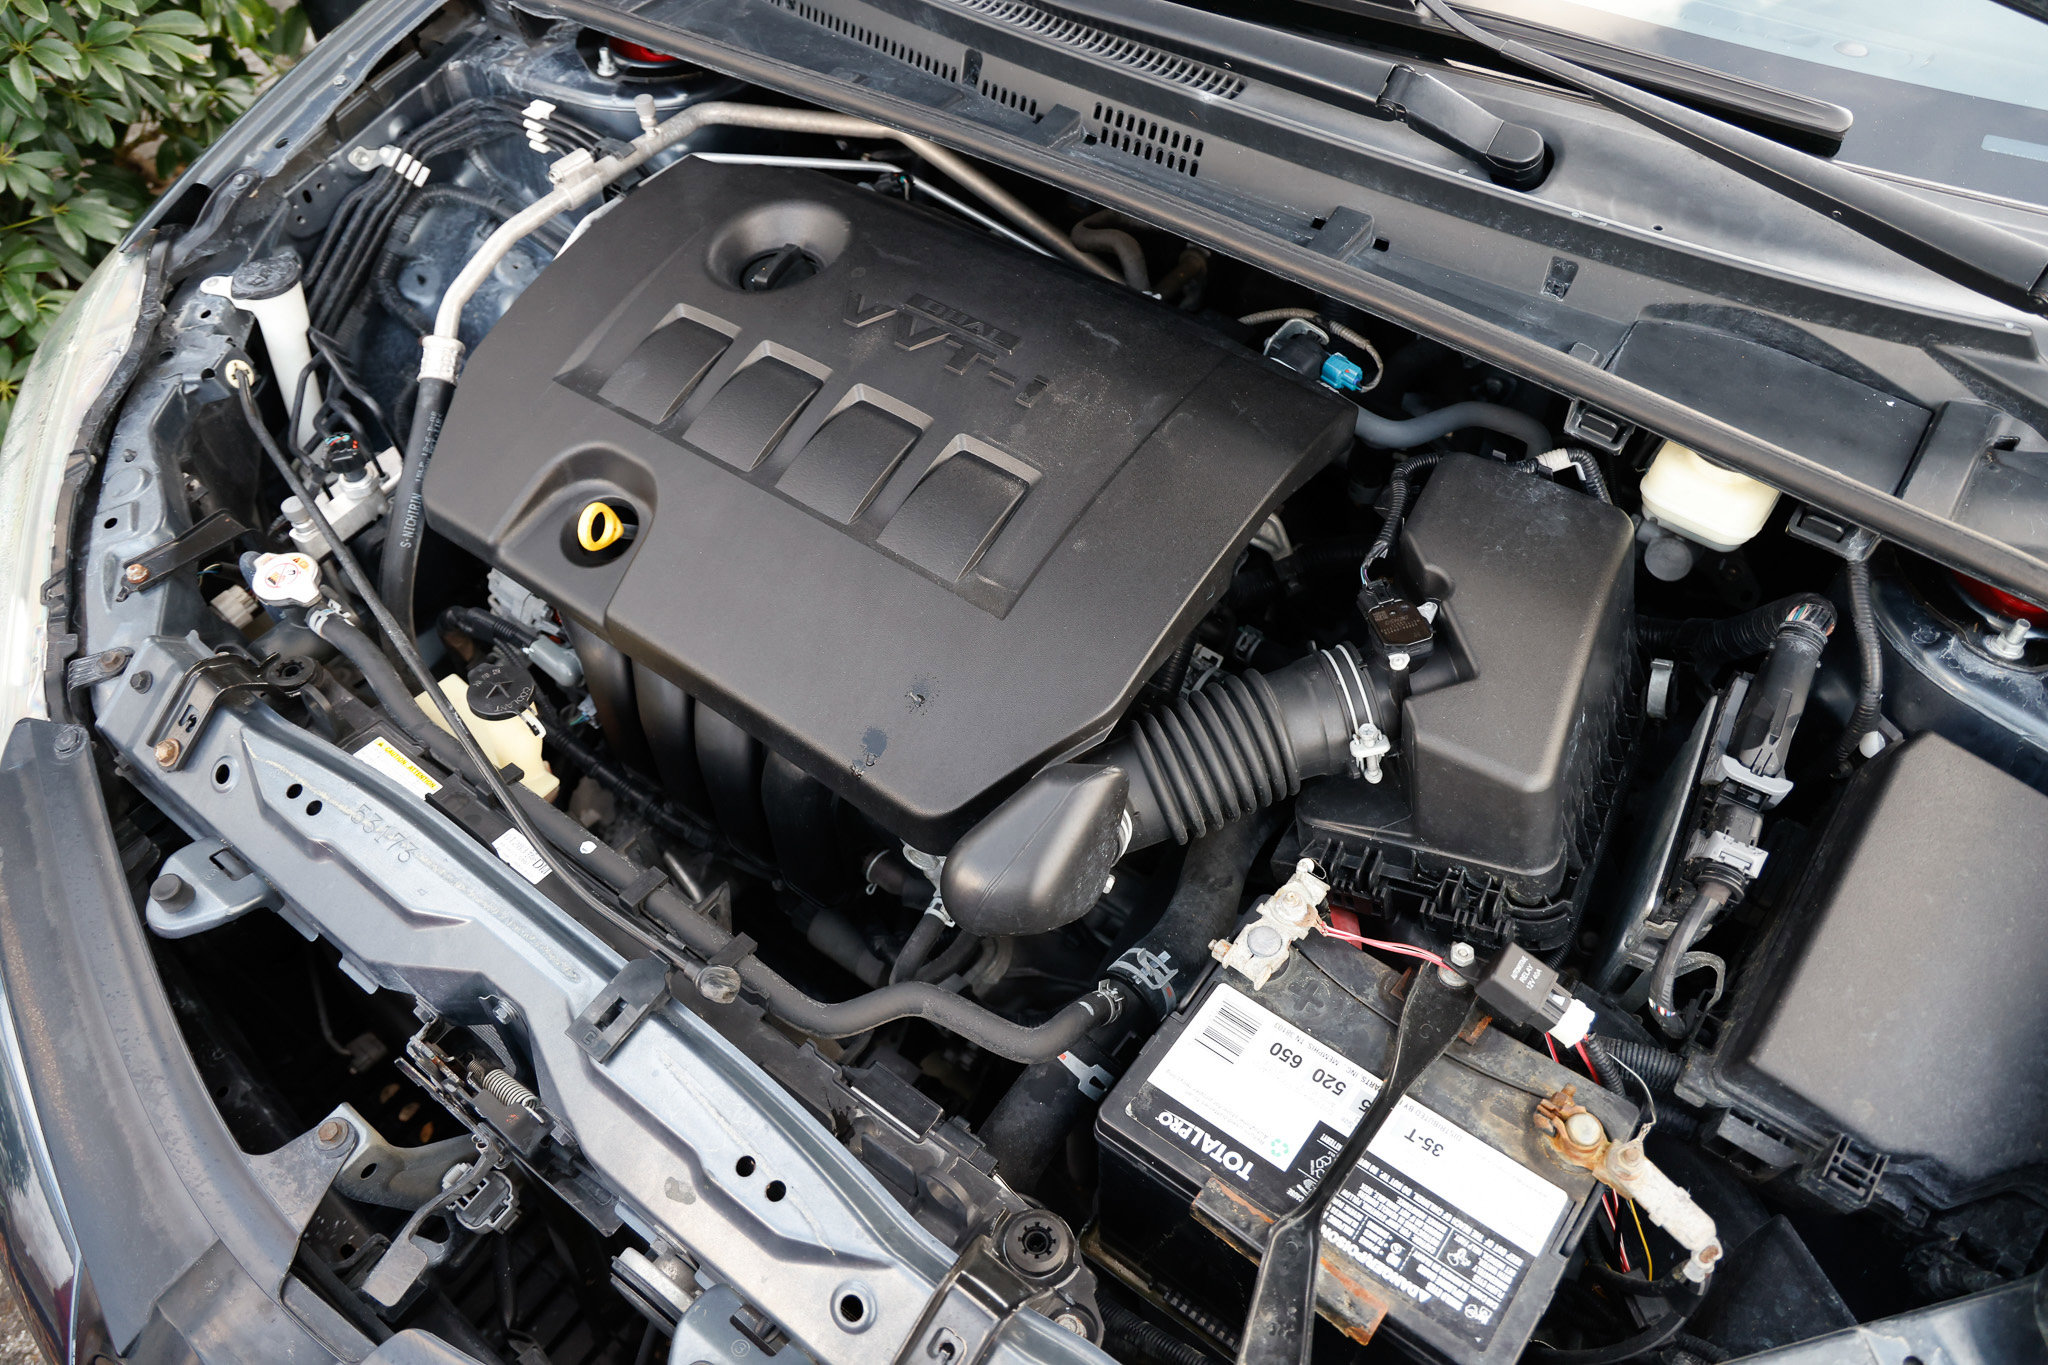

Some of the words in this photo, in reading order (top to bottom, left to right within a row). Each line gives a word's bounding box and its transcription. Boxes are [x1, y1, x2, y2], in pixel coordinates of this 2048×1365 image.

[921, 299, 1005, 344] DUAL
[494, 686, 531, 712] COOLANT
[384, 746, 408, 766] CAUTION
[407, 764, 436, 789] ATTENTION
[1519, 963, 1534, 984] RELAY
[1526, 977, 1536, 990] 12V
[1294, 1035, 1304, 1044] TN
[1267, 1040, 1304, 1070] 650
[1309, 1066, 1347, 1097] 520
[1403, 1102, 1414, 1112] BY
[1414, 1109, 1462, 1142] DISTRIBUTED
[1403, 1124, 1445, 1158] 35-T
[1359, 1182, 1374, 1195] SEEK
[1389, 1176, 1403, 1190] NOT
[1285, 1186, 1304, 1203] CAUSE
[1340, 1188, 1362, 1206] FOLLOW
[1411, 1191, 1444, 1216] CHILDREN.
[1342, 1203, 1363, 1221] SEVERE
[1377, 1202, 1399, 1220] VEHICLE
[1441, 1210, 1453, 1221] OF
[1450, 1215, 1473, 1234] REACH
[1470, 1228, 1485, 1242] THE
[1483, 1236, 1495, 1248] OF
[1466, 1241, 1483, 1256] HELP
[1492, 1242, 1507, 1256] OUT
[1505, 1250, 1523, 1266] KEEP
